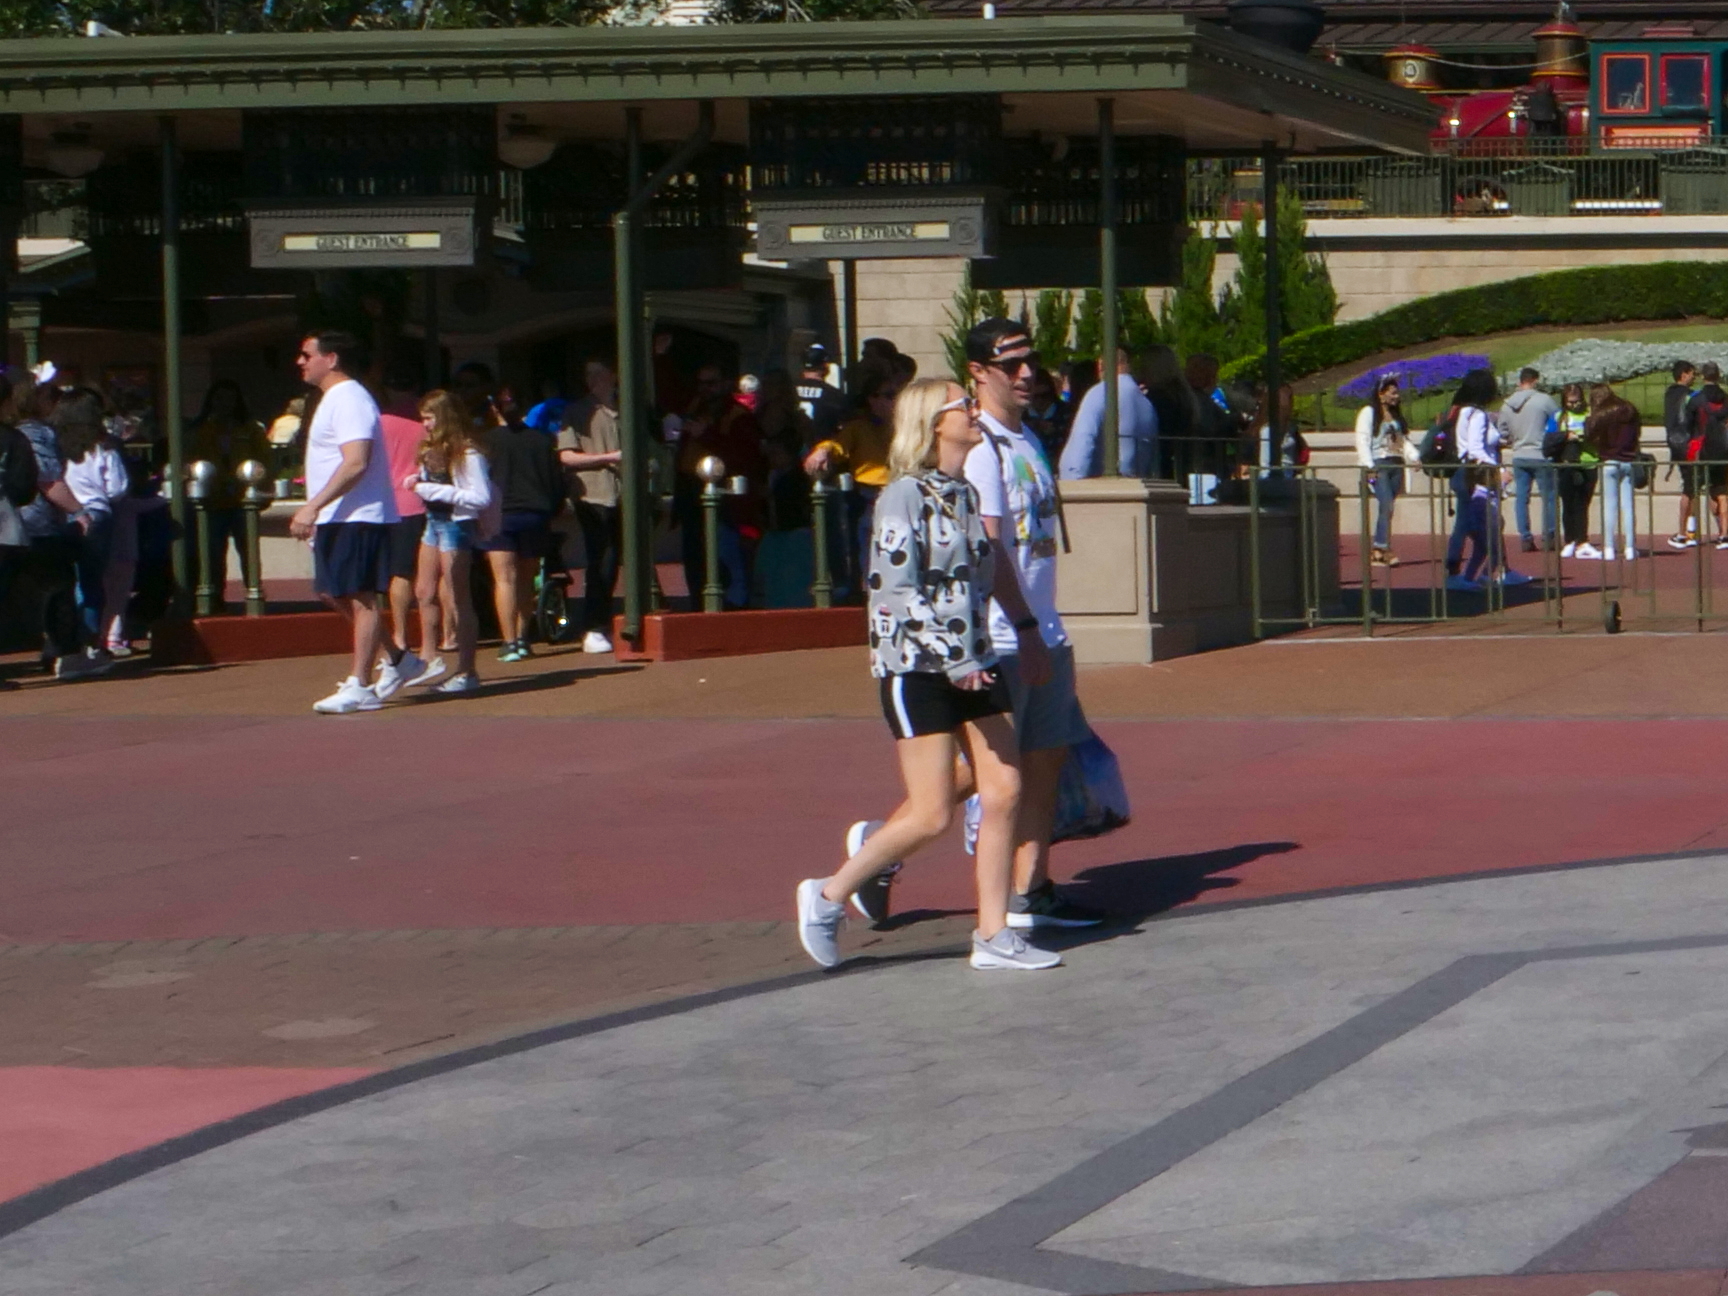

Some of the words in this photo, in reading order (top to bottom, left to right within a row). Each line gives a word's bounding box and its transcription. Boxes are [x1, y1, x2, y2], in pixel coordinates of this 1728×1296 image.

[823, 225, 857, 239] GUEST
[861, 223, 917, 238] ENTRANCE
[316, 236, 350, 249] GUEST
